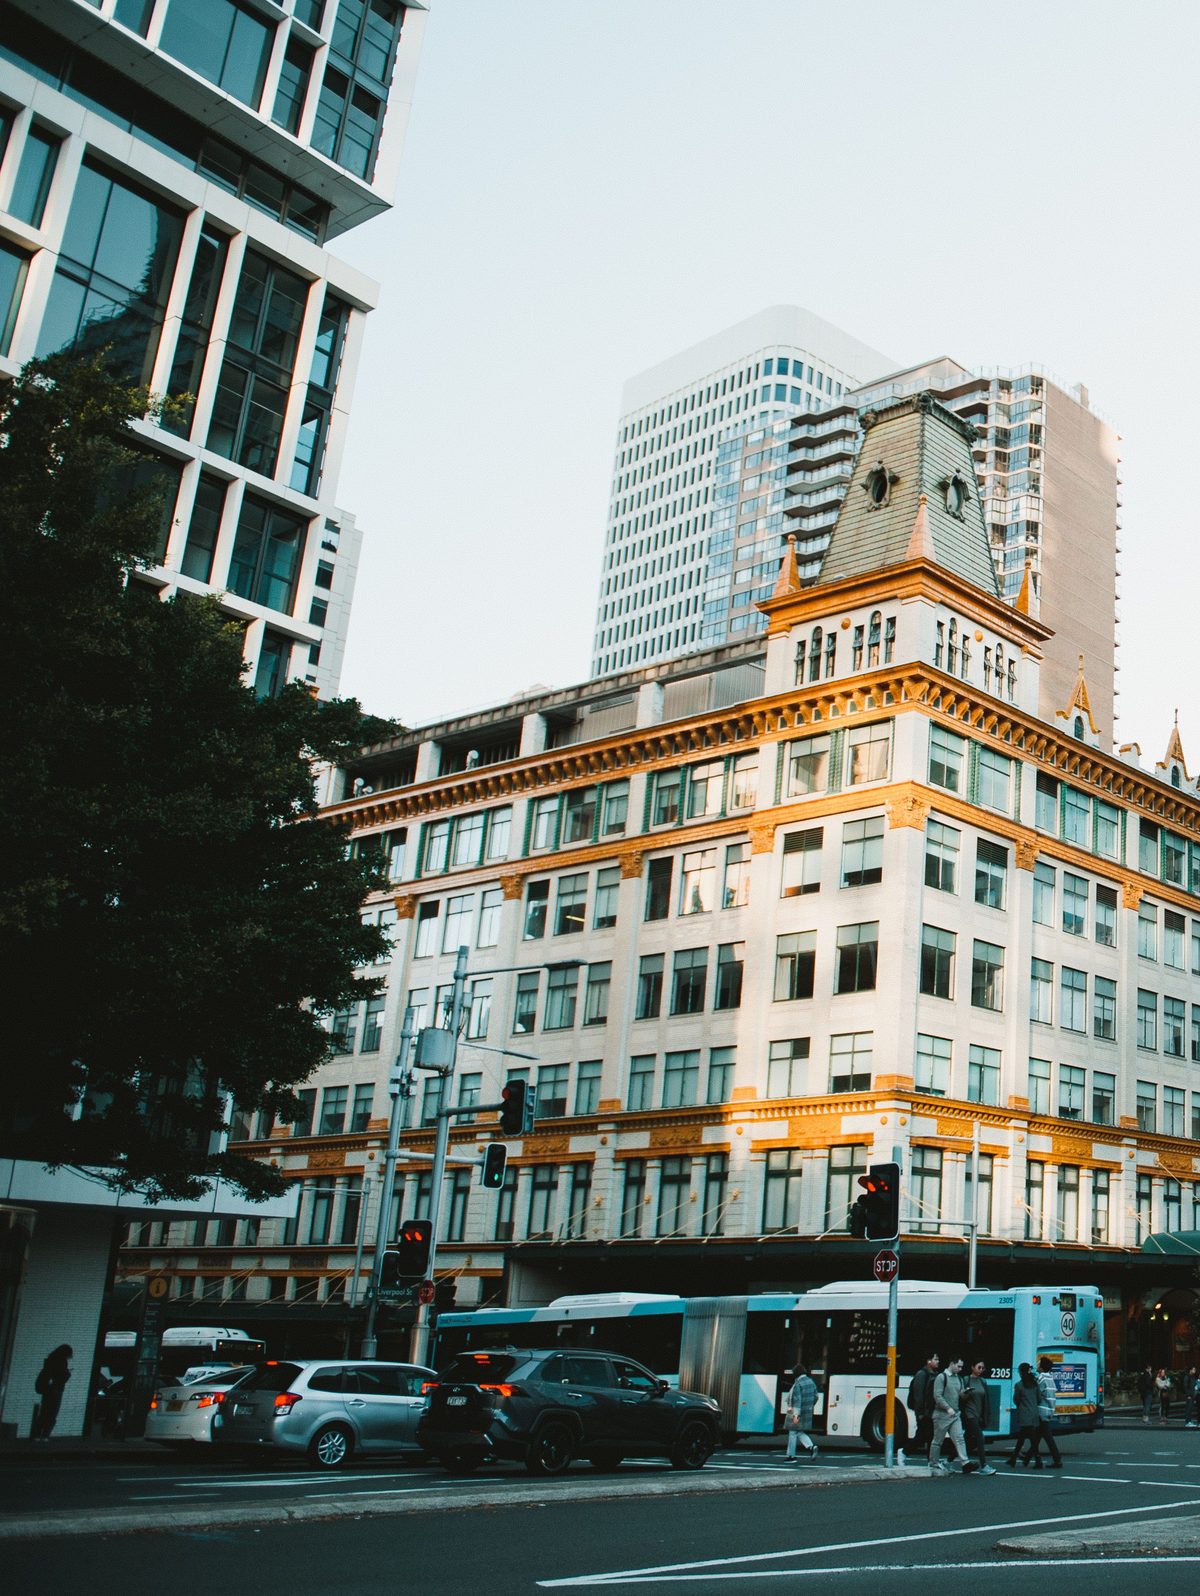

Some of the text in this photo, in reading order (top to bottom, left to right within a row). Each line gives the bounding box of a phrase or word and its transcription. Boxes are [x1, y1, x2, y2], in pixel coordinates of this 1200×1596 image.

[876, 1260, 897, 1272] STOP
[378, 1287, 405, 1297] Liverpool
[1063, 1318, 1073, 1331] 40
[990, 1368, 1011, 1378] 2305
